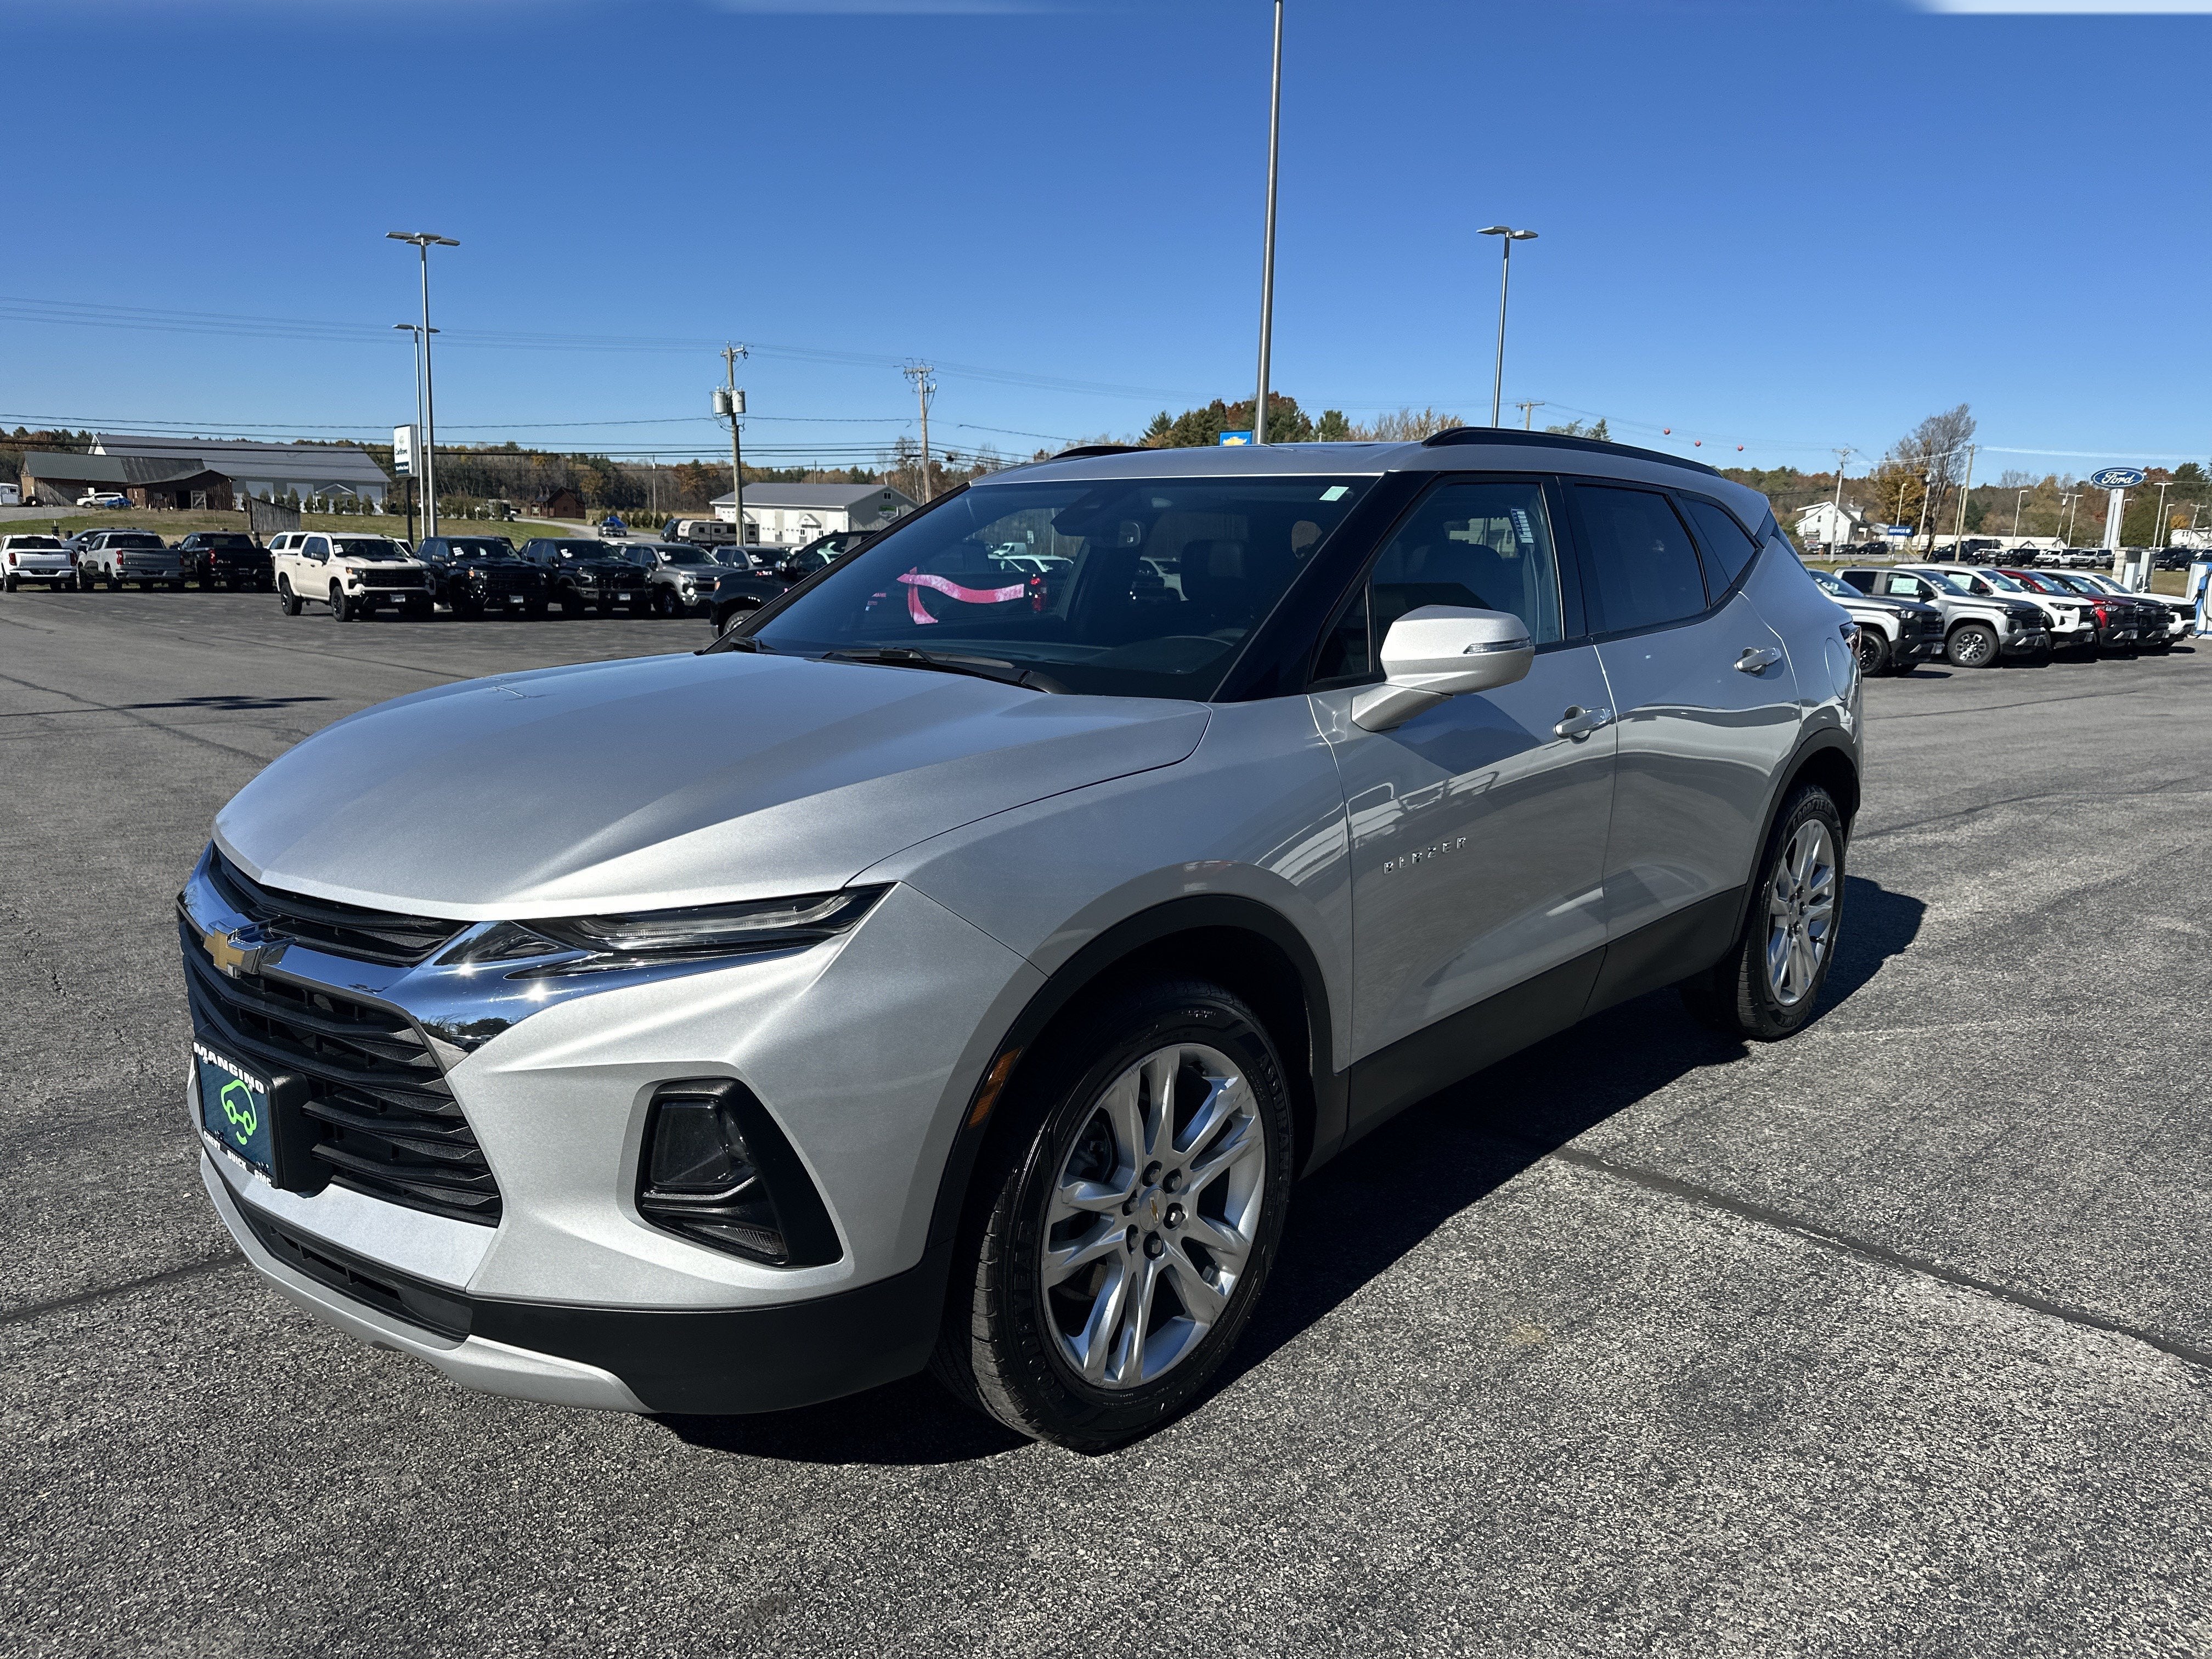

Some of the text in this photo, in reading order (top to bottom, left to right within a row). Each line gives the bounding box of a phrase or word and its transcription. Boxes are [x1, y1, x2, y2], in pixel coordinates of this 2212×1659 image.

[2102, 471, 2135, 484] Ford
[1384, 837, 1466, 875] BLAZER
[193, 1042, 264, 1094] MANGINO
[203, 1130, 272, 1187] CHEVY BUICK GMC
